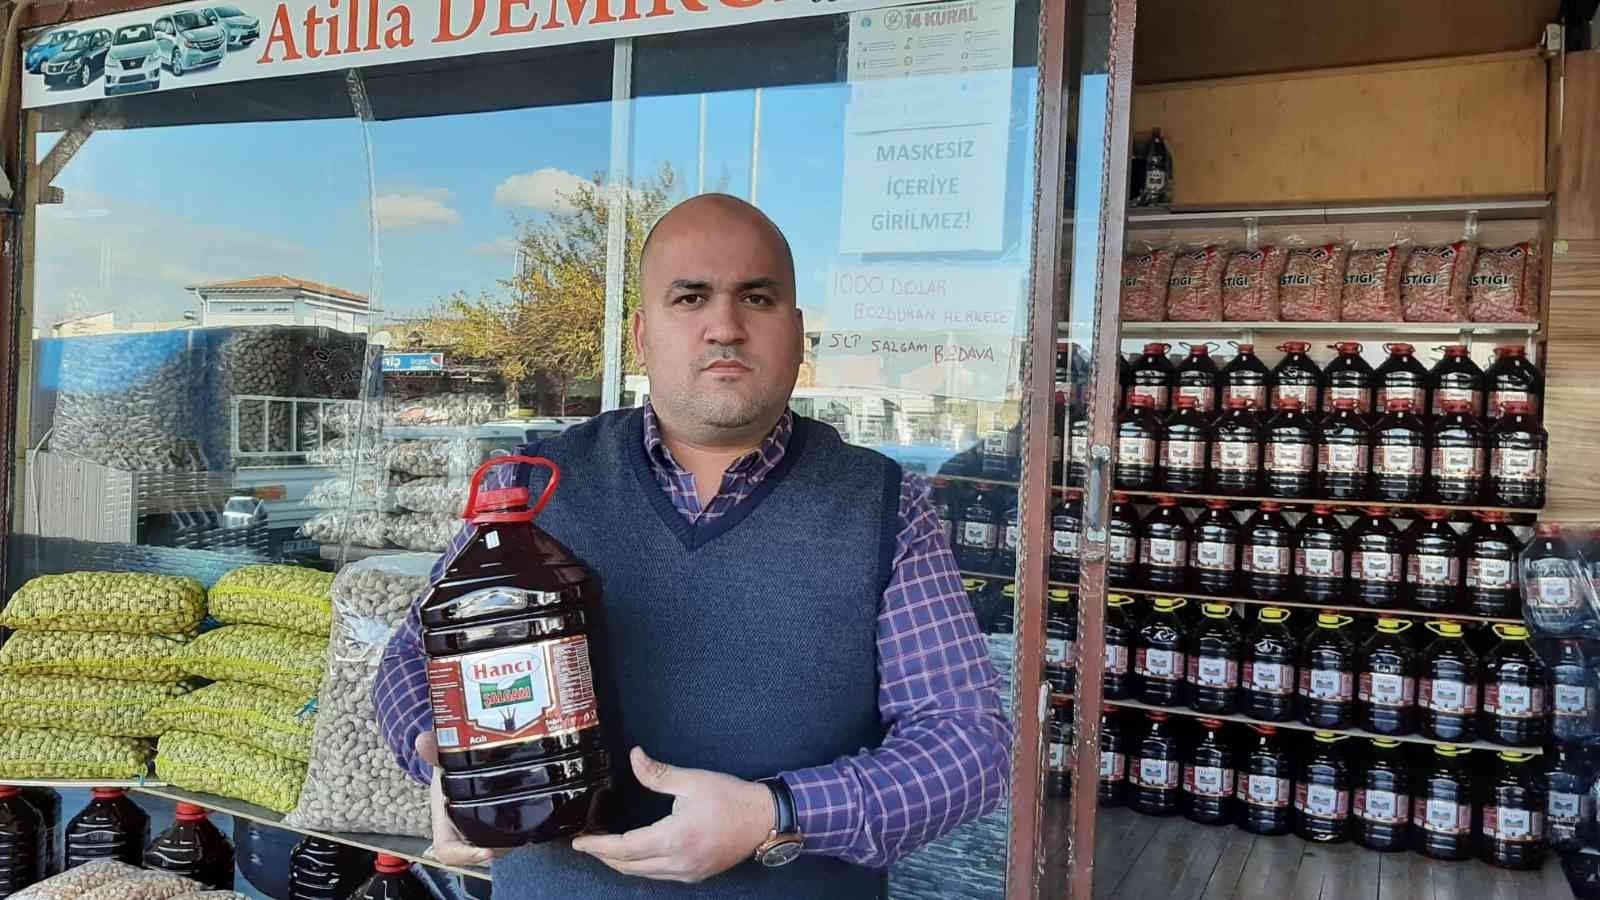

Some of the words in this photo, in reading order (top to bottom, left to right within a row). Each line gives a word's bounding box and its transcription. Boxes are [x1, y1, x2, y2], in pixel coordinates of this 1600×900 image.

[924, 6, 978, 26] KURAL
[256, 0, 415, 64] Atilla
[876, 137, 975, 162] MASKESİZ
[886, 172, 960, 199] İÇERİYE
[872, 208, 971, 231] GİRİLMEZ!
